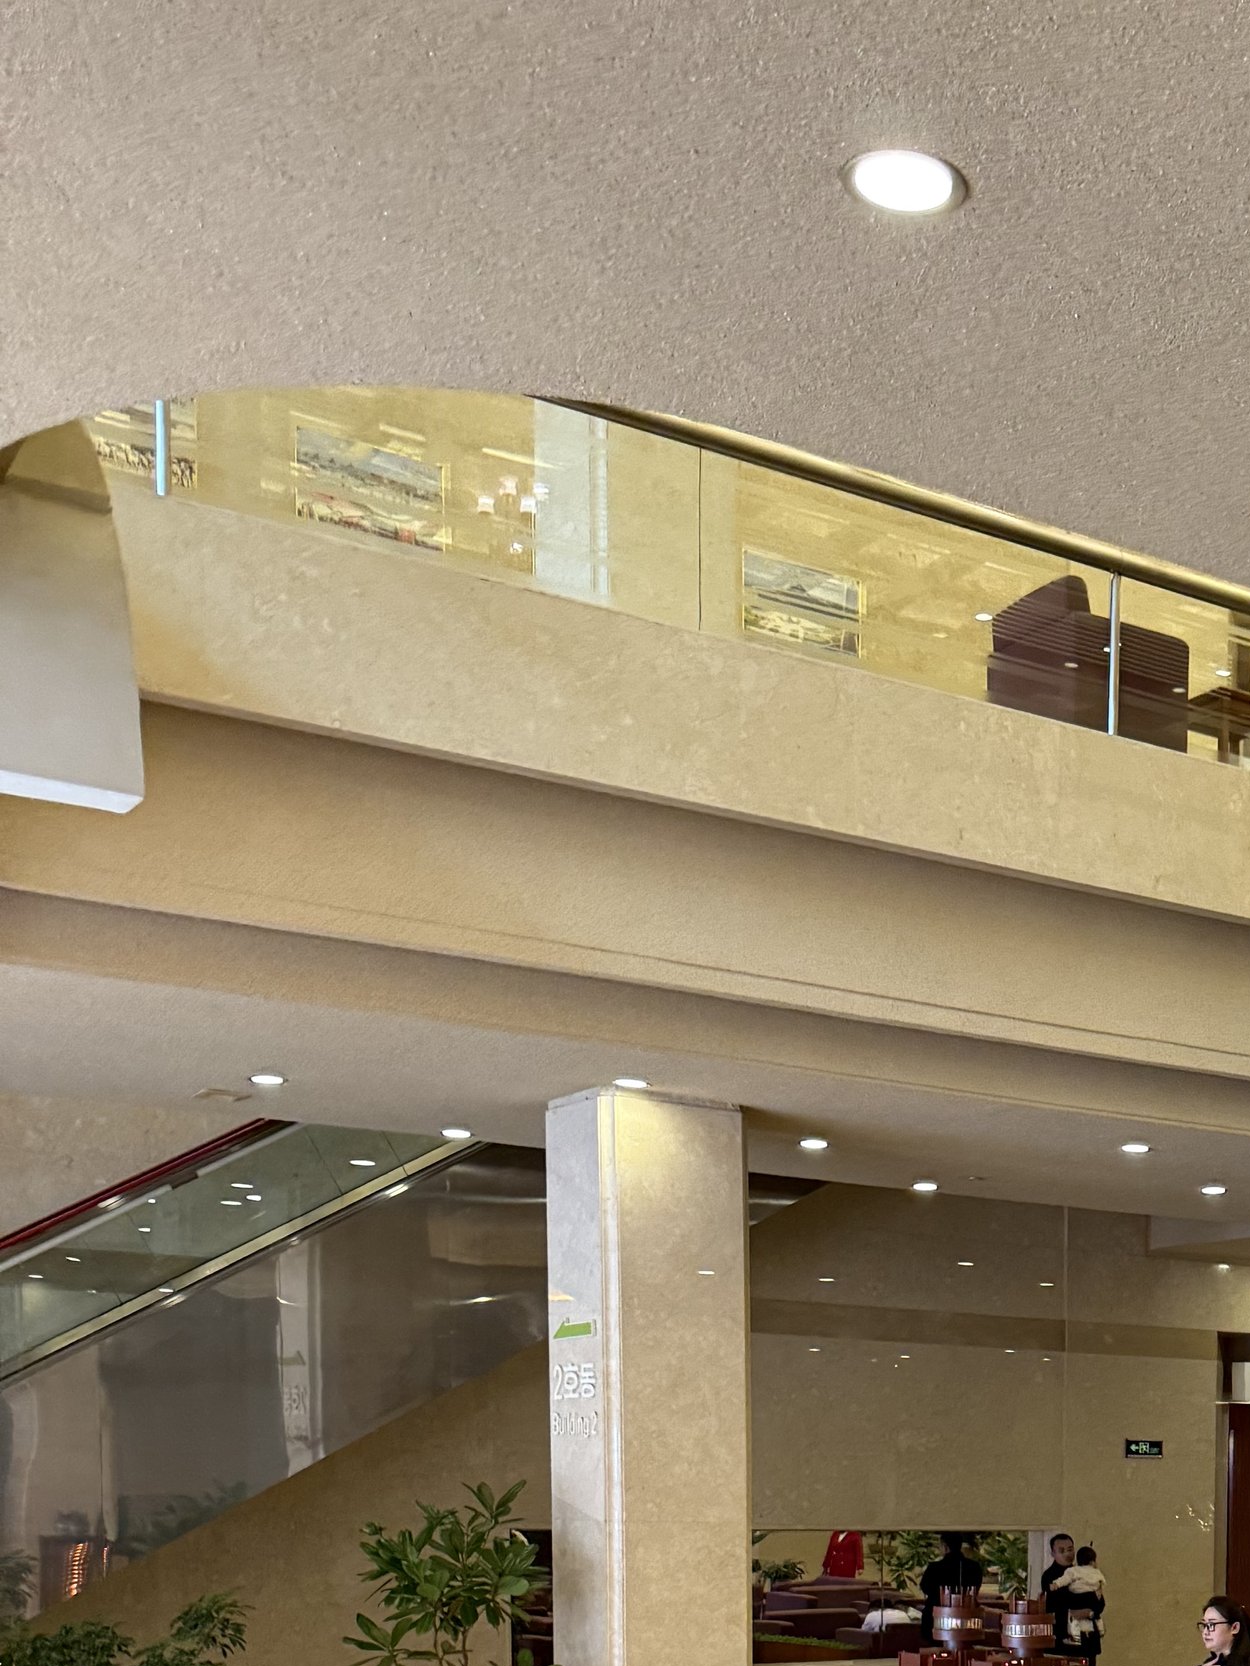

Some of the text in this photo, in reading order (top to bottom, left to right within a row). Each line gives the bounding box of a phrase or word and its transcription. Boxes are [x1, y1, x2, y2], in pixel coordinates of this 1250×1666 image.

[553, 1361, 596, 1401] 2호동
[552, 1410, 598, 1438] Building 2
